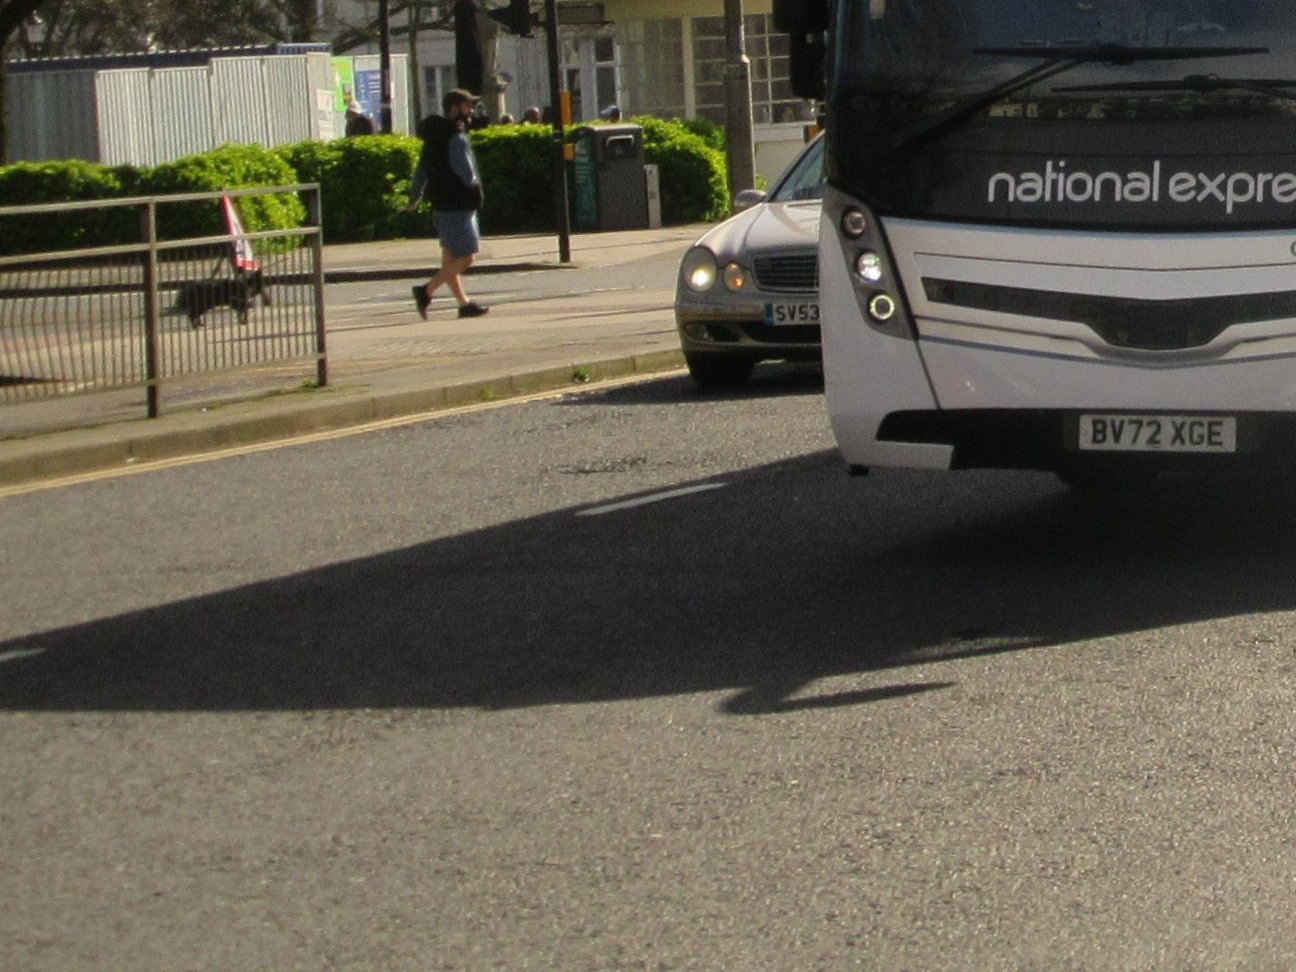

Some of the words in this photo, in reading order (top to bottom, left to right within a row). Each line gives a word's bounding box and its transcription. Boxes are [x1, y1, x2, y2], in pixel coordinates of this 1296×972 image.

[988, 160, 1160, 202] national
[775, 304, 820, 321] SV53
[1091, 419, 1161, 445] BV72
[1171, 420, 1223, 446] XGE
